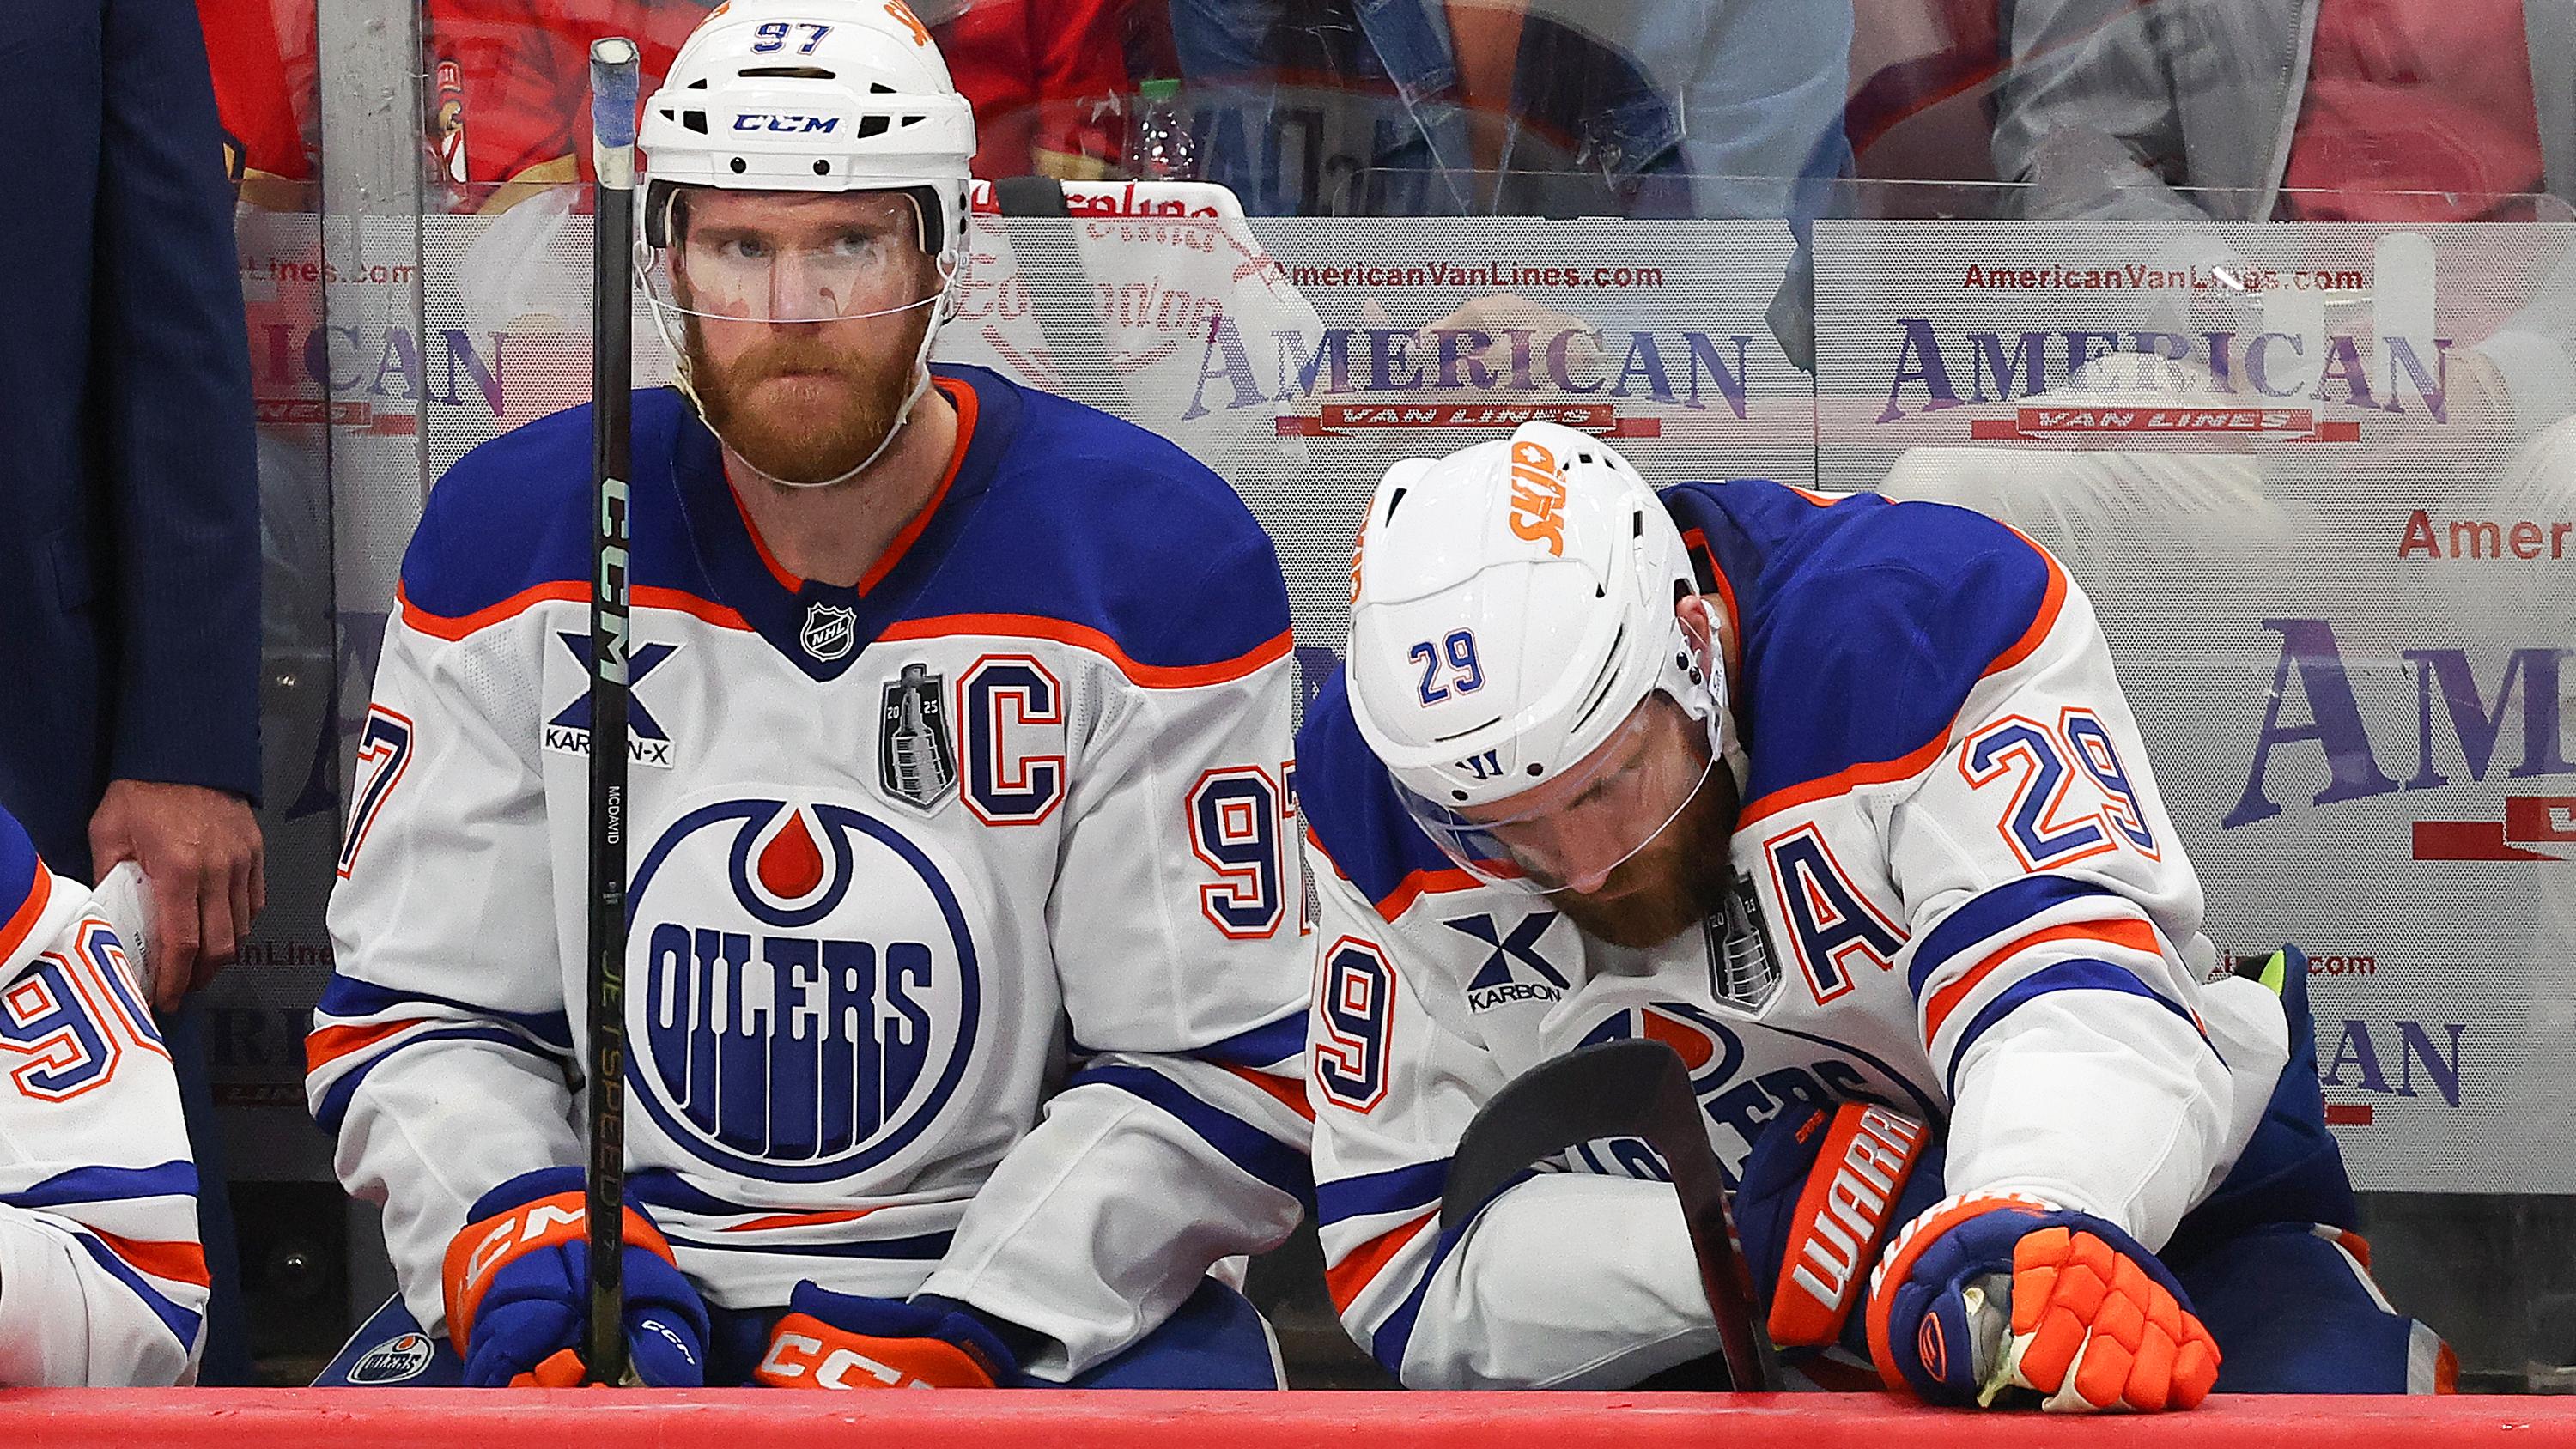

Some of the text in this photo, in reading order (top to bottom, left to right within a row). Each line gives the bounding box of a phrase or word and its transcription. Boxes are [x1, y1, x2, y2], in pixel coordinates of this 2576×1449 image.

[750, 22, 834, 55] 97
[732, 114, 840, 135] CCM
[1266, 254, 1663, 288] AmericanVanLines.com
[1181, 314, 1753, 420] AMERICAN
[1875, 319, 2453, 424] AMERICAN
[1343, 408, 1591, 423] VAN LINES
[2039, 411, 2292, 429] VAN LINES
[600, 478, 631, 687] CCM
[811, 620, 846, 646] NHL
[1408, 627, 1487, 709] 29
[886, 700, 939, 720] 20 25
[545, 728, 670, 765] KARN-X
[957, 654, 1065, 827] C
[607, 785, 620, 846] MCDAVID
[1959, 706, 2161, 874] 29
[1763, 821, 1912, 1007] A
[0, 919, 173, 1103] 90
[1315, 935, 1396, 1115] 9
[1467, 984, 1562, 1013] KARBON
[647, 923, 933, 1161] OILERS
[641, 1319, 696, 1366] CCM
[761, 1332, 935, 1390] CC
